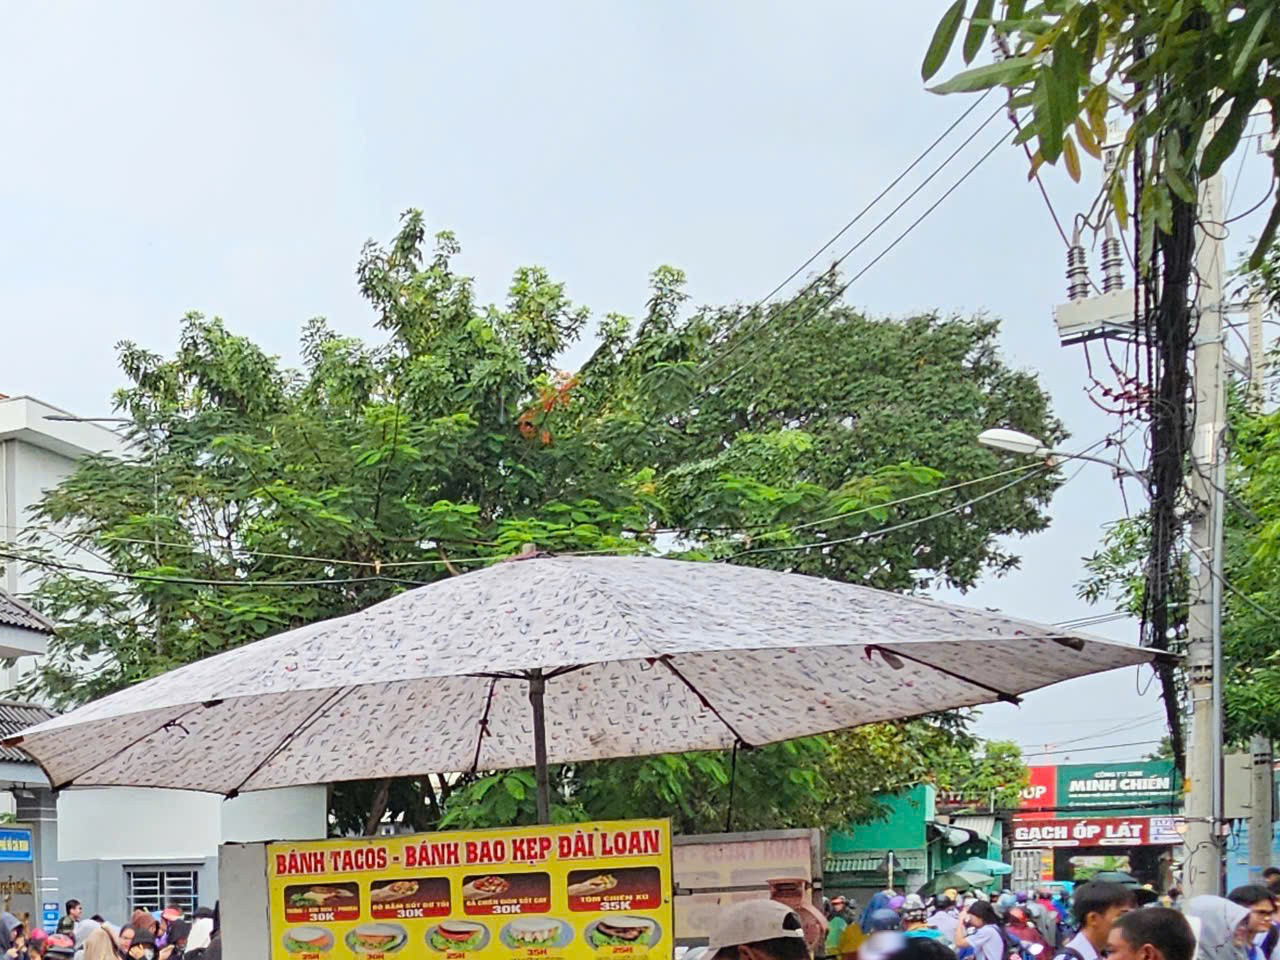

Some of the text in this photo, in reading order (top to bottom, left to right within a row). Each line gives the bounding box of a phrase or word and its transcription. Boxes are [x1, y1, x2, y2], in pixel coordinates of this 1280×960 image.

[1069, 774, 1170, 793] MINH CHIẾN
[1015, 826, 1068, 843] GẠCH
[1073, 820, 1100, 838] ỐP
[1105, 821, 1143, 838] LÁT
[275, 847, 325, 875] BÁNH
[329, 847, 387, 871] TACOS
[404, 839, 460, 868] BÁNH
[465, 840, 504, 863] BAO
[512, 836, 553, 866] KẸP
[558, 829, 595, 858] ĐÀI
[601, 829, 661, 856] LOAN
[492, 904, 521, 914] 30K
[599, 901, 631, 911] 35K
[309, 911, 335, 921] 30K
[396, 908, 424, 918] 30K
